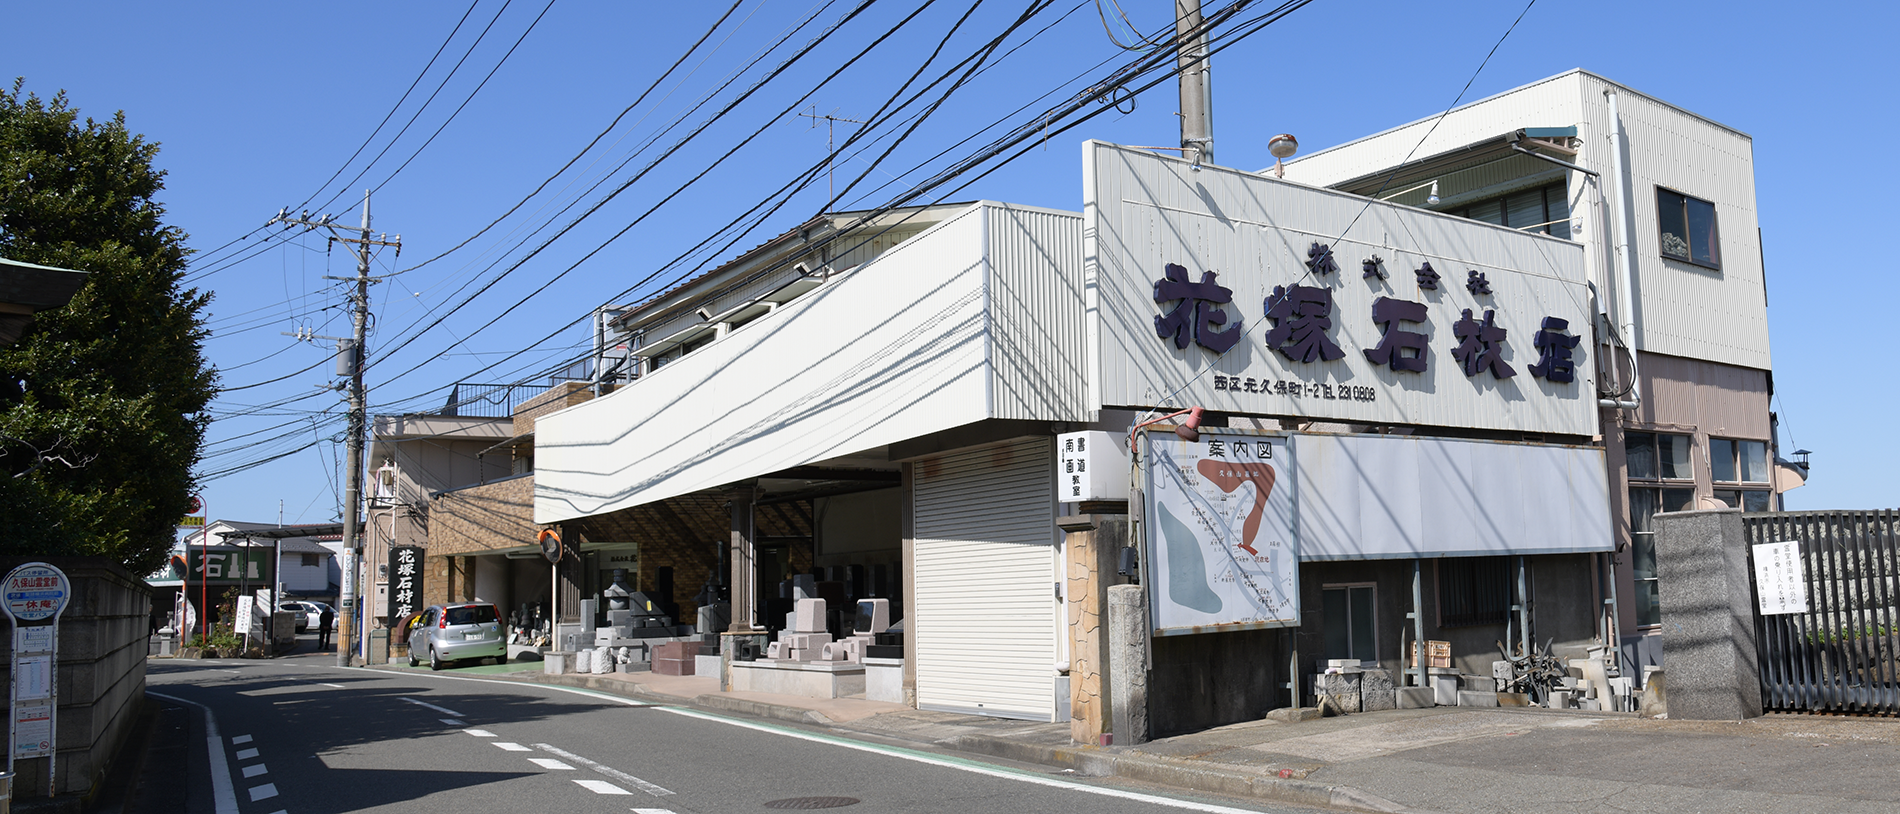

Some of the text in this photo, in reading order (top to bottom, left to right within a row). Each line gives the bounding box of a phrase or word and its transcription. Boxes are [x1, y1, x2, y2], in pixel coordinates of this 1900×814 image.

[1307, 242, 1494, 296] 株式会社
[1321, 383, 1335, 399] TEL
[1076, 437, 1086, 473] 書道
[1208, 439, 1272, 459] 案内図
[1071, 475, 1081, 497] 教室
[195, 553, 226, 578] 石
[12, 577, 58, 589] 久保山霊堂前
[395, 549, 416, 619] 花塚石材店
[12, 600, 52, 609] 一休庵
